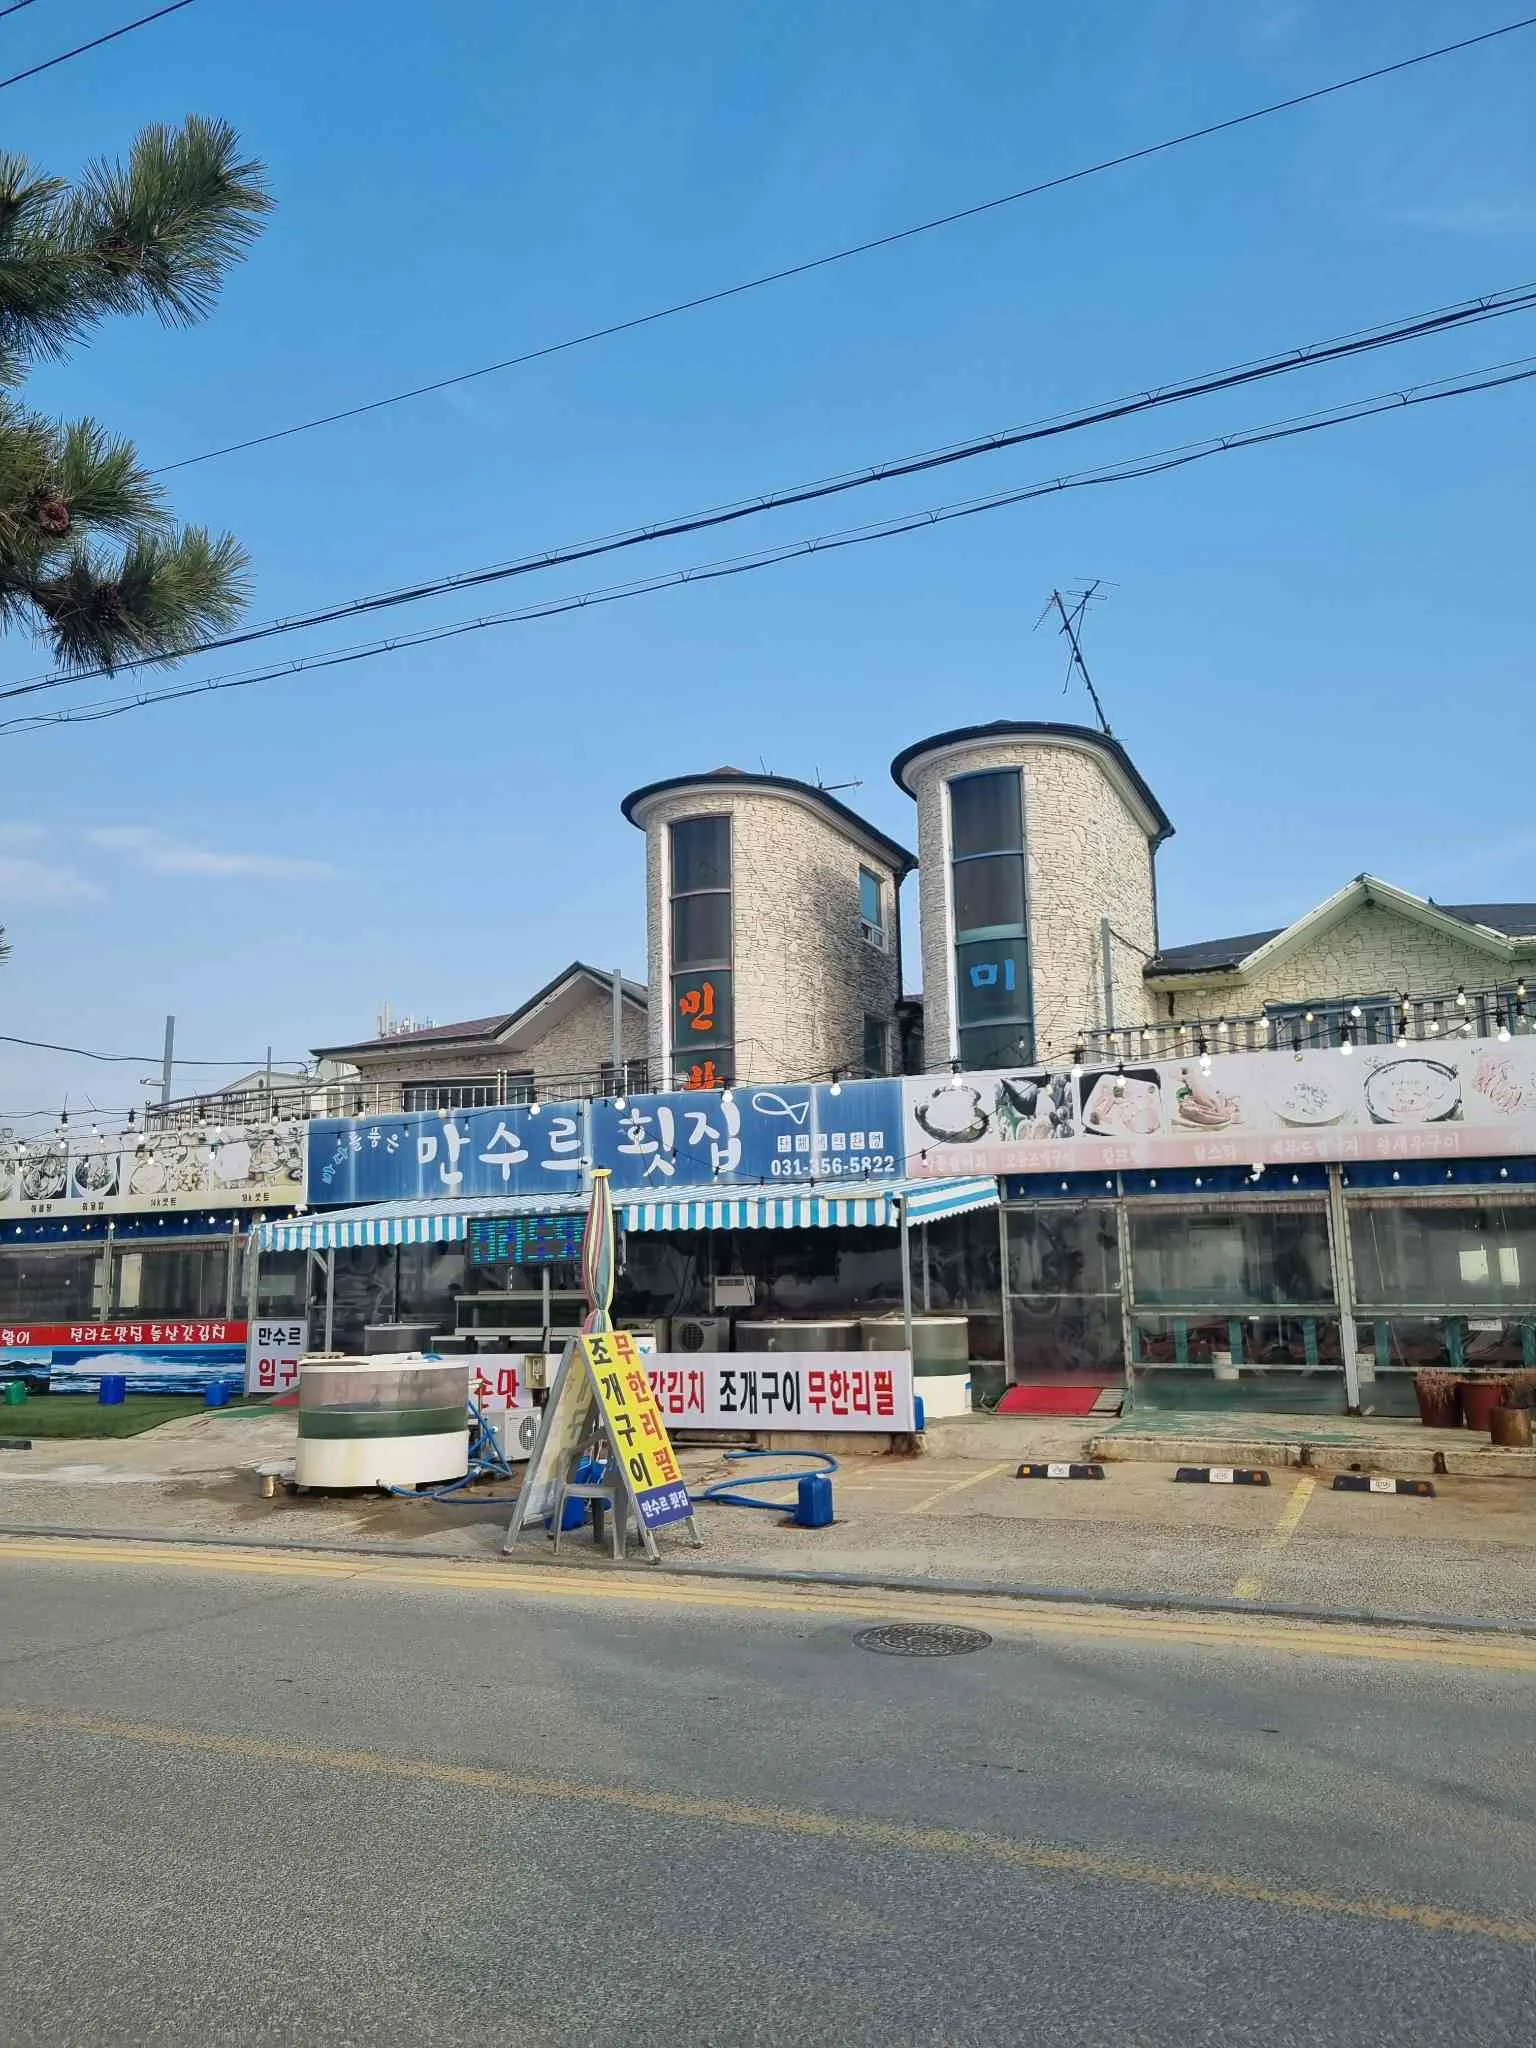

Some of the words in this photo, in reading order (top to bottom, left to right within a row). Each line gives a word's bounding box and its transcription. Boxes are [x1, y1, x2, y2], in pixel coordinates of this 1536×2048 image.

[969, 959, 1015, 990] 미
[417, 1123, 592, 1185] 만수르
[617, 1102, 742, 1177] 횟집
[771, 1155, 895, 1176] 031-356-5822
[70, 1326, 142, 1343] 전라도맛집
[258, 1327, 301, 1346] 만수르
[258, 1359, 298, 1387] 입구
[719, 1370, 800, 1415] 조개구이
[808, 1370, 895, 1415] 무한리필
[588, 1337, 653, 1488] 조개구이
[614, 1334, 678, 1482] 무한리필
[641, 1496, 671, 1518] 만수르
[668, 1489, 689, 1509] 횟집
